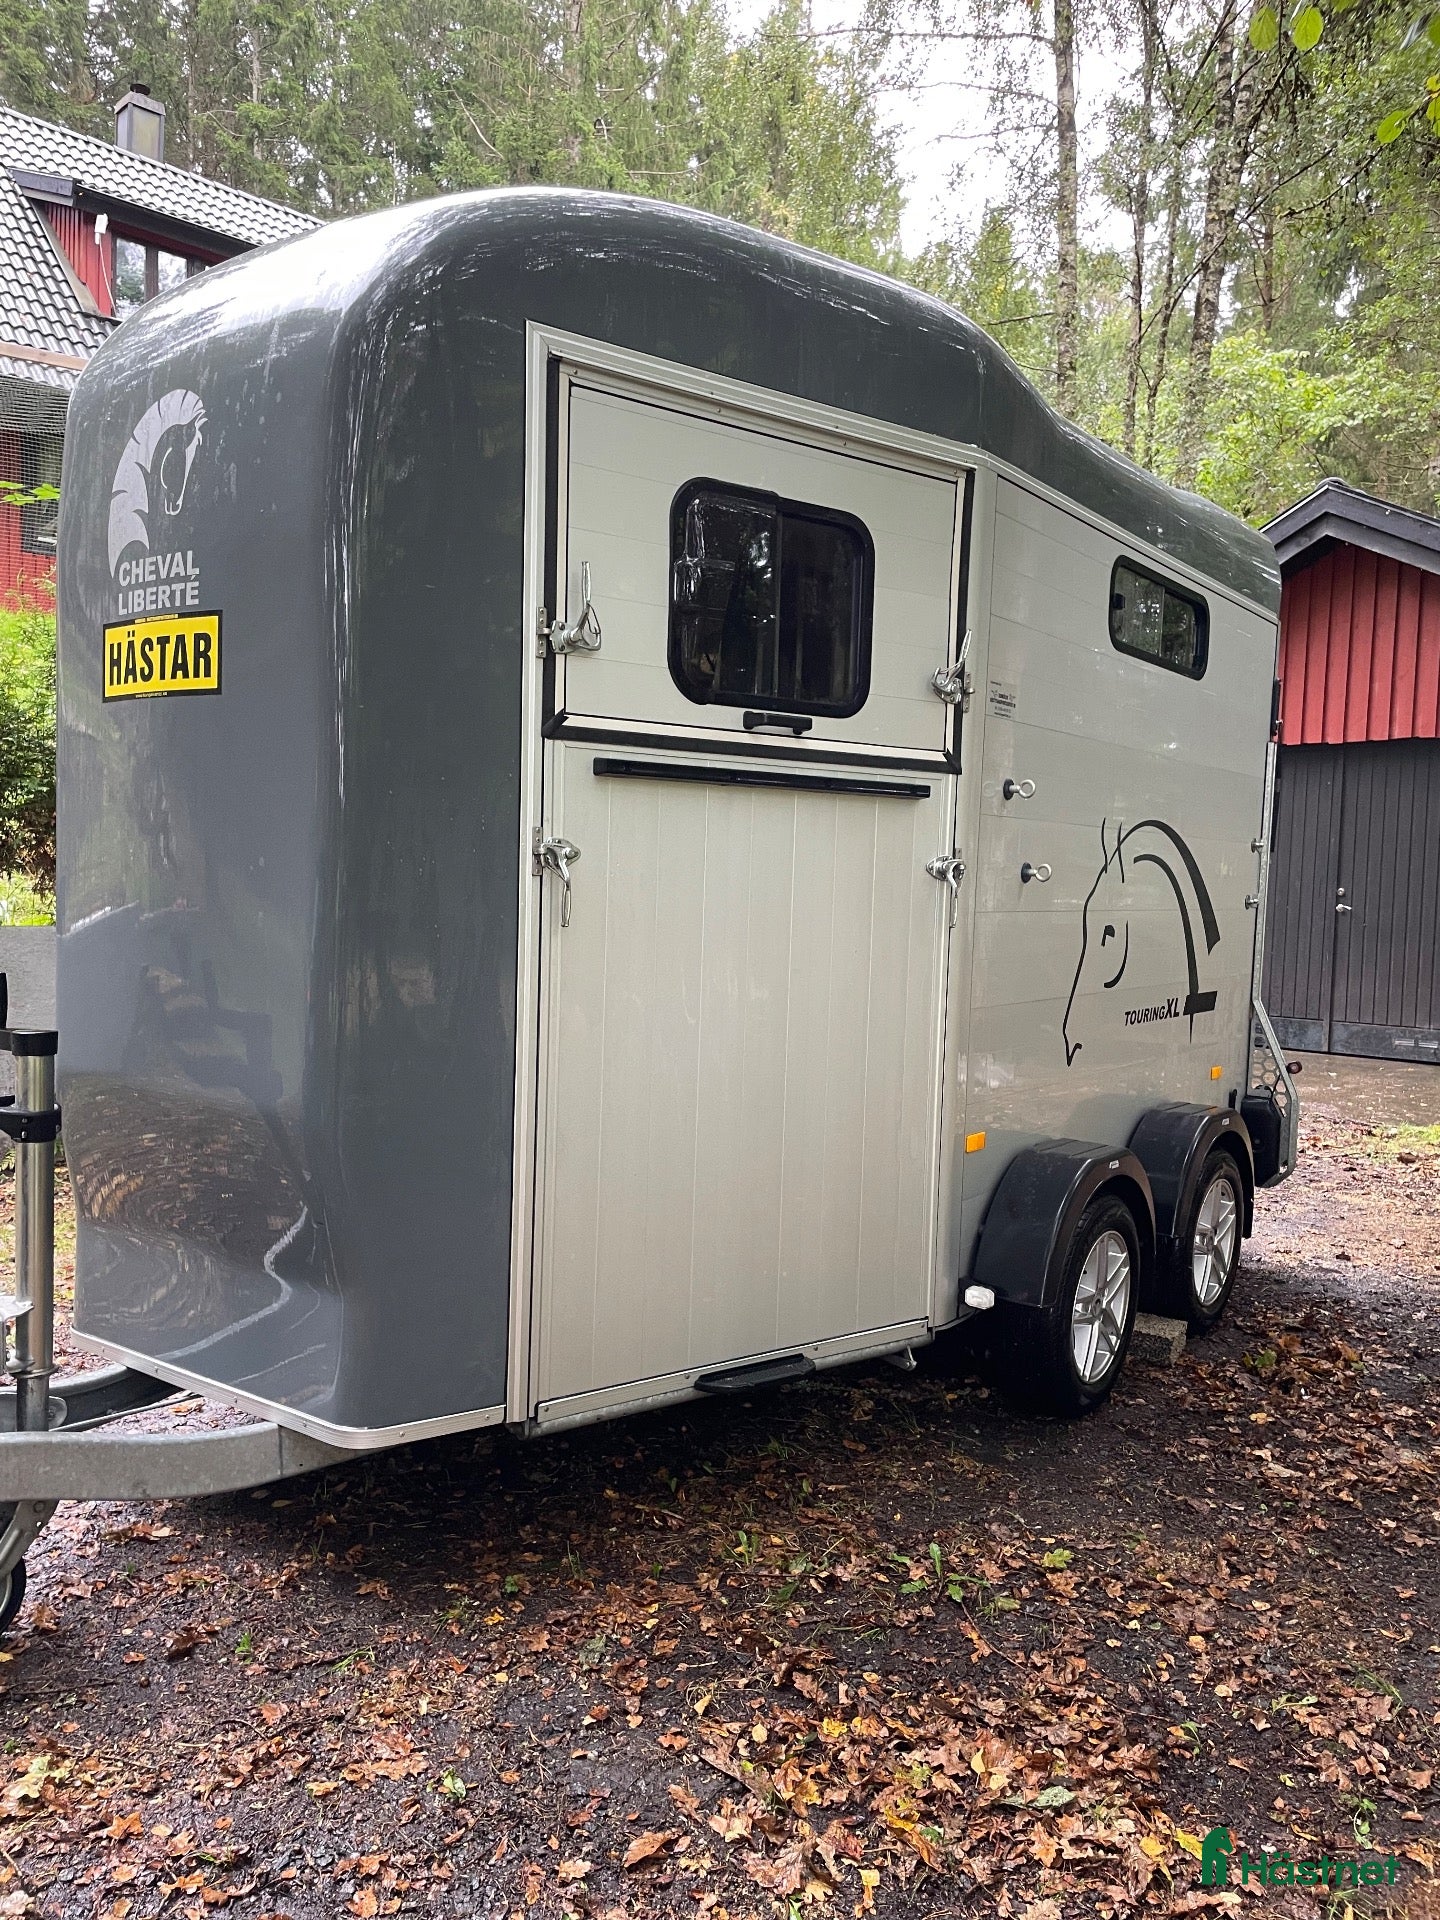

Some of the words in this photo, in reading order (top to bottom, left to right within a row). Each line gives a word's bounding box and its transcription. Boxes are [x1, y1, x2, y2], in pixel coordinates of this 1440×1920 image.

[118, 550, 200, 587] CHEVAL
[118, 575, 200, 616] LIBERTÉ
[109, 630, 212, 687] HÄSTAR
